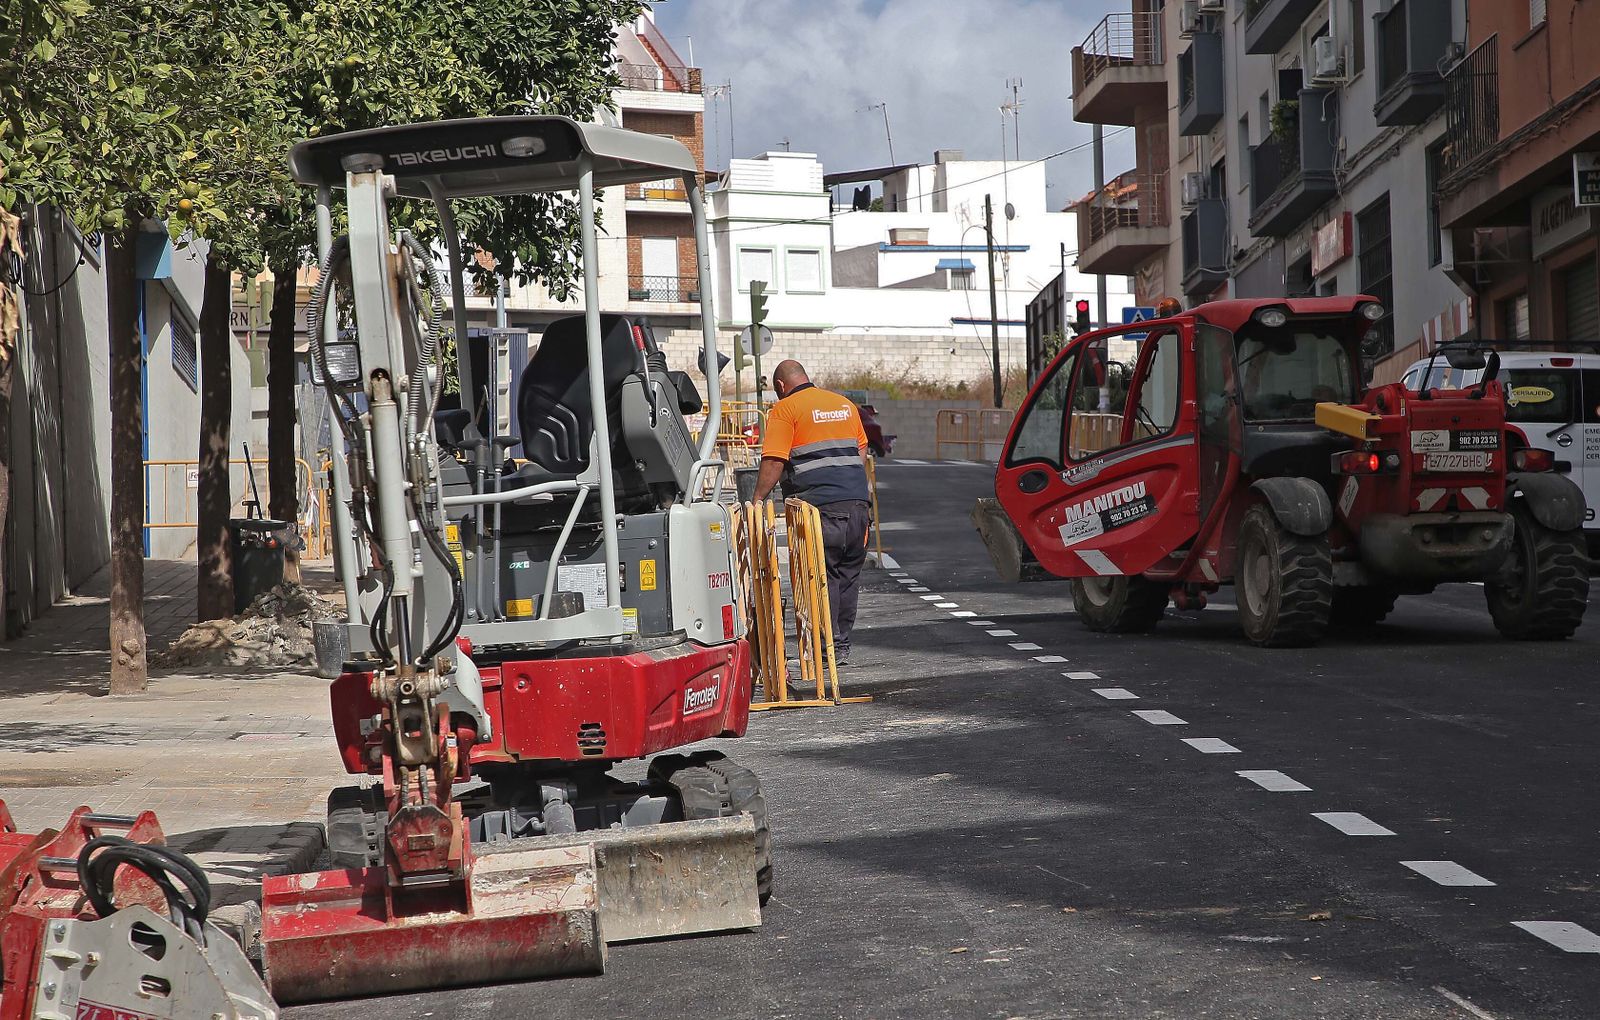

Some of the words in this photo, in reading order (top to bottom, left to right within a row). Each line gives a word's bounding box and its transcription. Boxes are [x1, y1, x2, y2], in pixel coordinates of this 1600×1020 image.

[1460, 436, 1471, 445] 902
[1472, 436, 1480, 445] 70
[1481, 435, 1489, 444] 23
[1489, 435, 1497, 444] 24
[1065, 481, 1146, 523] MANITOU
[1110, 513, 1122, 523] 902
[1122, 510, 1131, 519] 70
[1131, 506, 1140, 516] 23
[1139, 503, 1148, 513] 24
